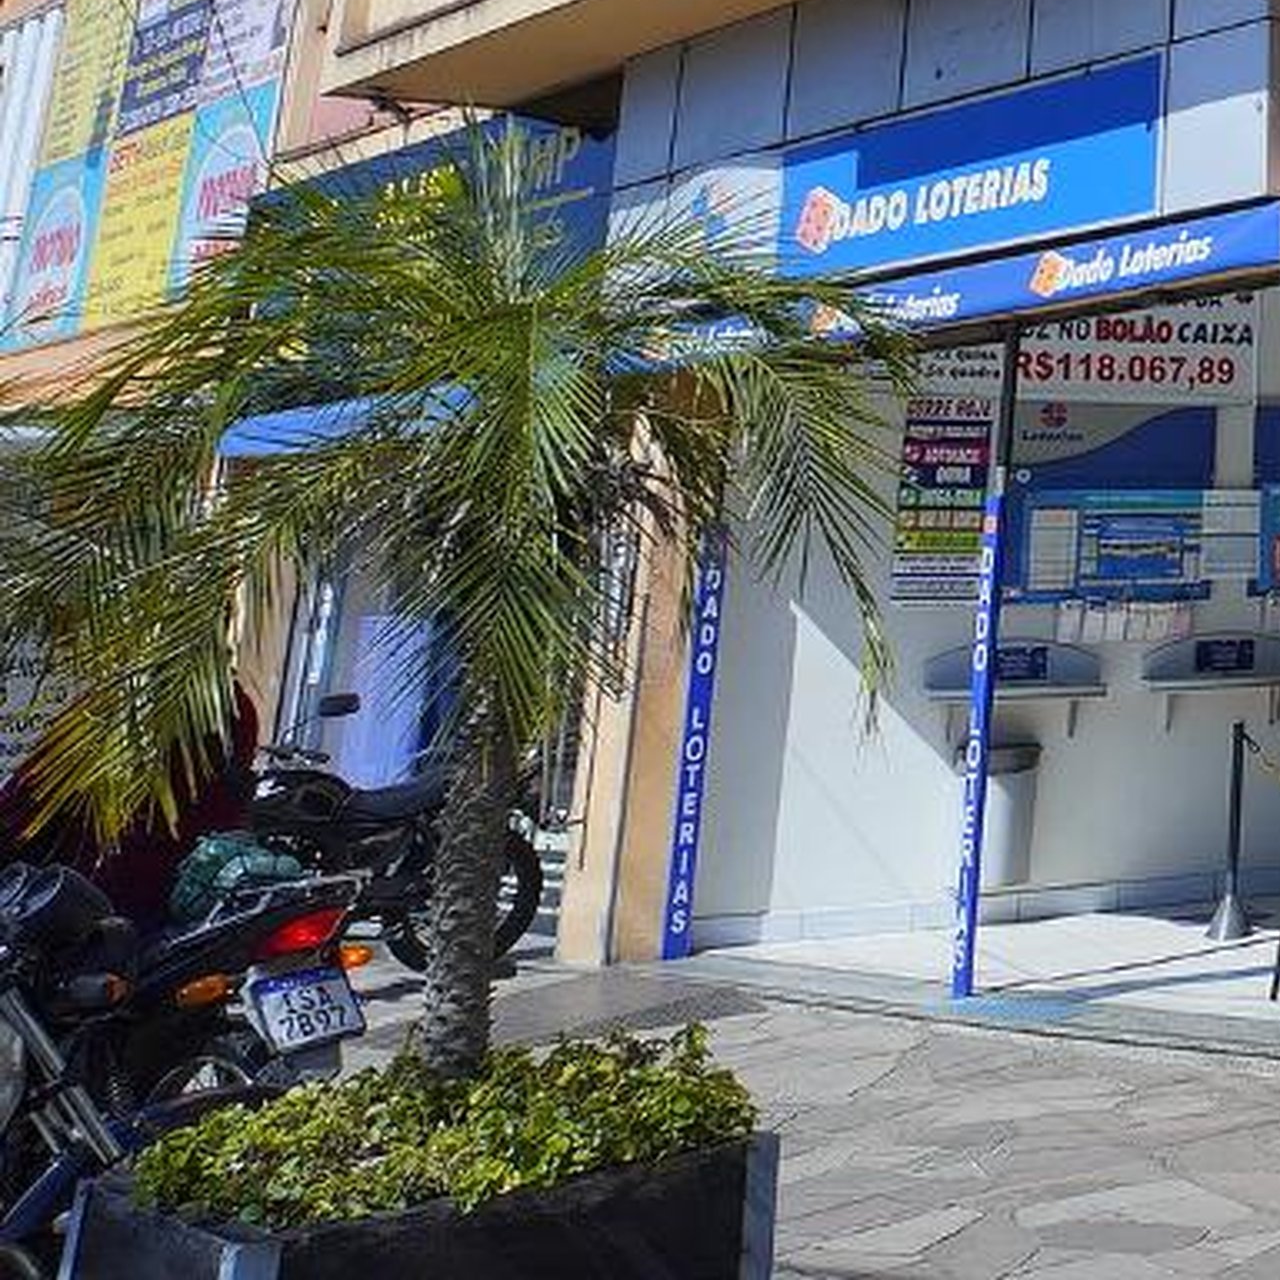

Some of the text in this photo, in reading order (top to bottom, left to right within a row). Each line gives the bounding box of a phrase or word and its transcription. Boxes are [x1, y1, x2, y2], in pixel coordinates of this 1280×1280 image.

[832, 158, 1051, 241] DADO LOTERIAS
[1055, 230, 1214, 290] Dado Loterias
[1059, 319, 1091, 341] NO
[1177, 322, 1254, 345] CAIXA
[1014, 350, 1236, 390] R$118.067,89
[671, 706, 705, 935] LOTERIAS
